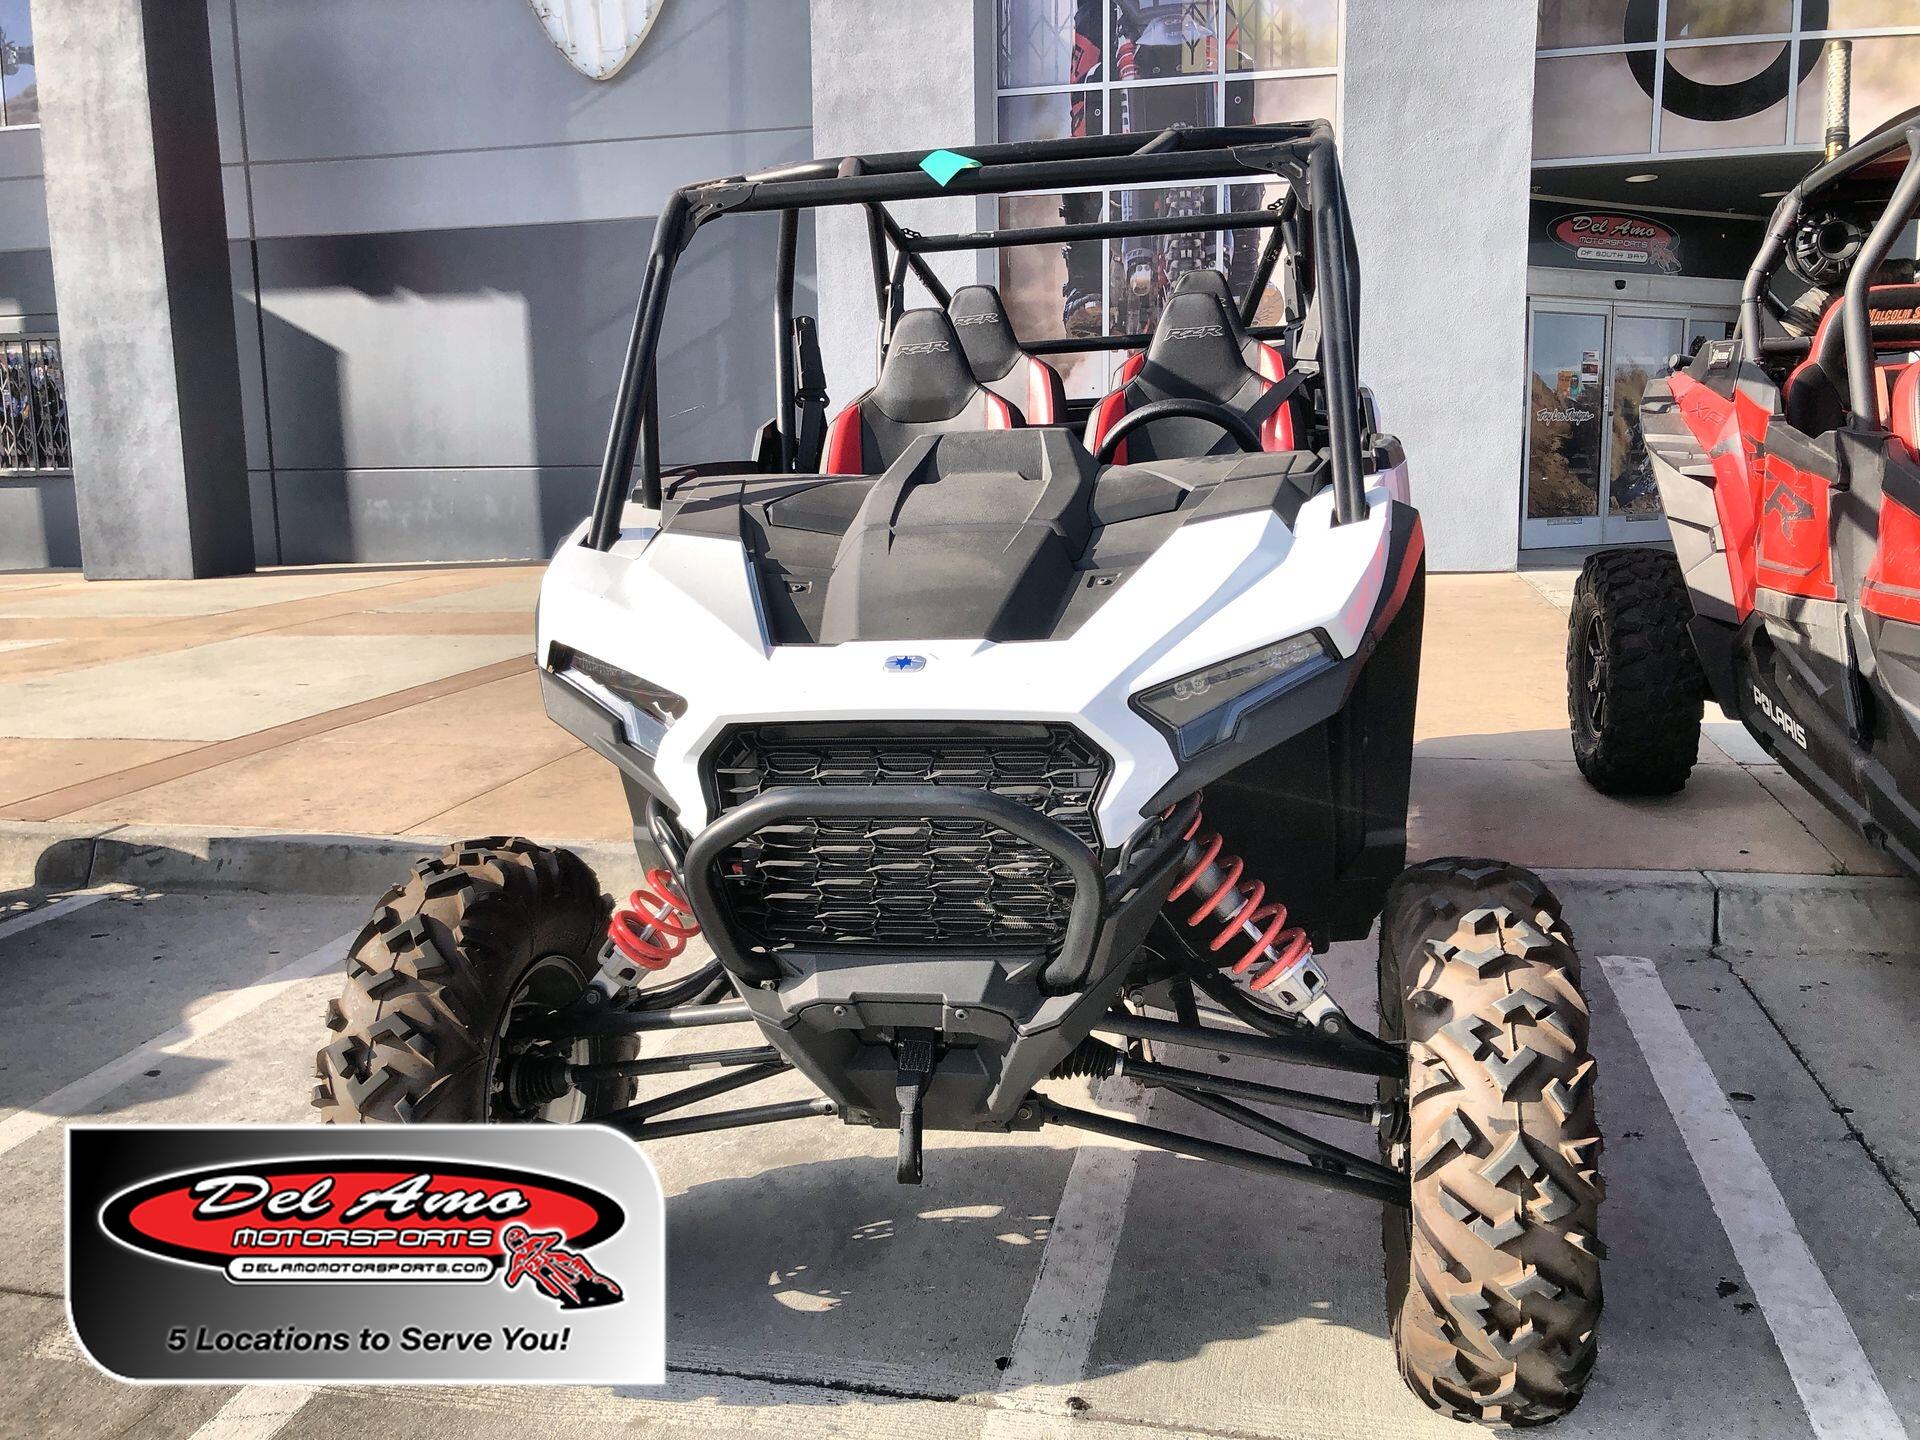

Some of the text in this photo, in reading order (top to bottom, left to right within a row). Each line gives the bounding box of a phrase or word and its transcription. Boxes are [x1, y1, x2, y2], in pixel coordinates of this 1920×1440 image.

[1573, 216, 1656, 237] Del Amo
[1578, 236, 1649, 249] MOTORSPORTS
[1595, 251, 1624, 259] SOUTH
[1753, 684, 1807, 750] POLARIS
